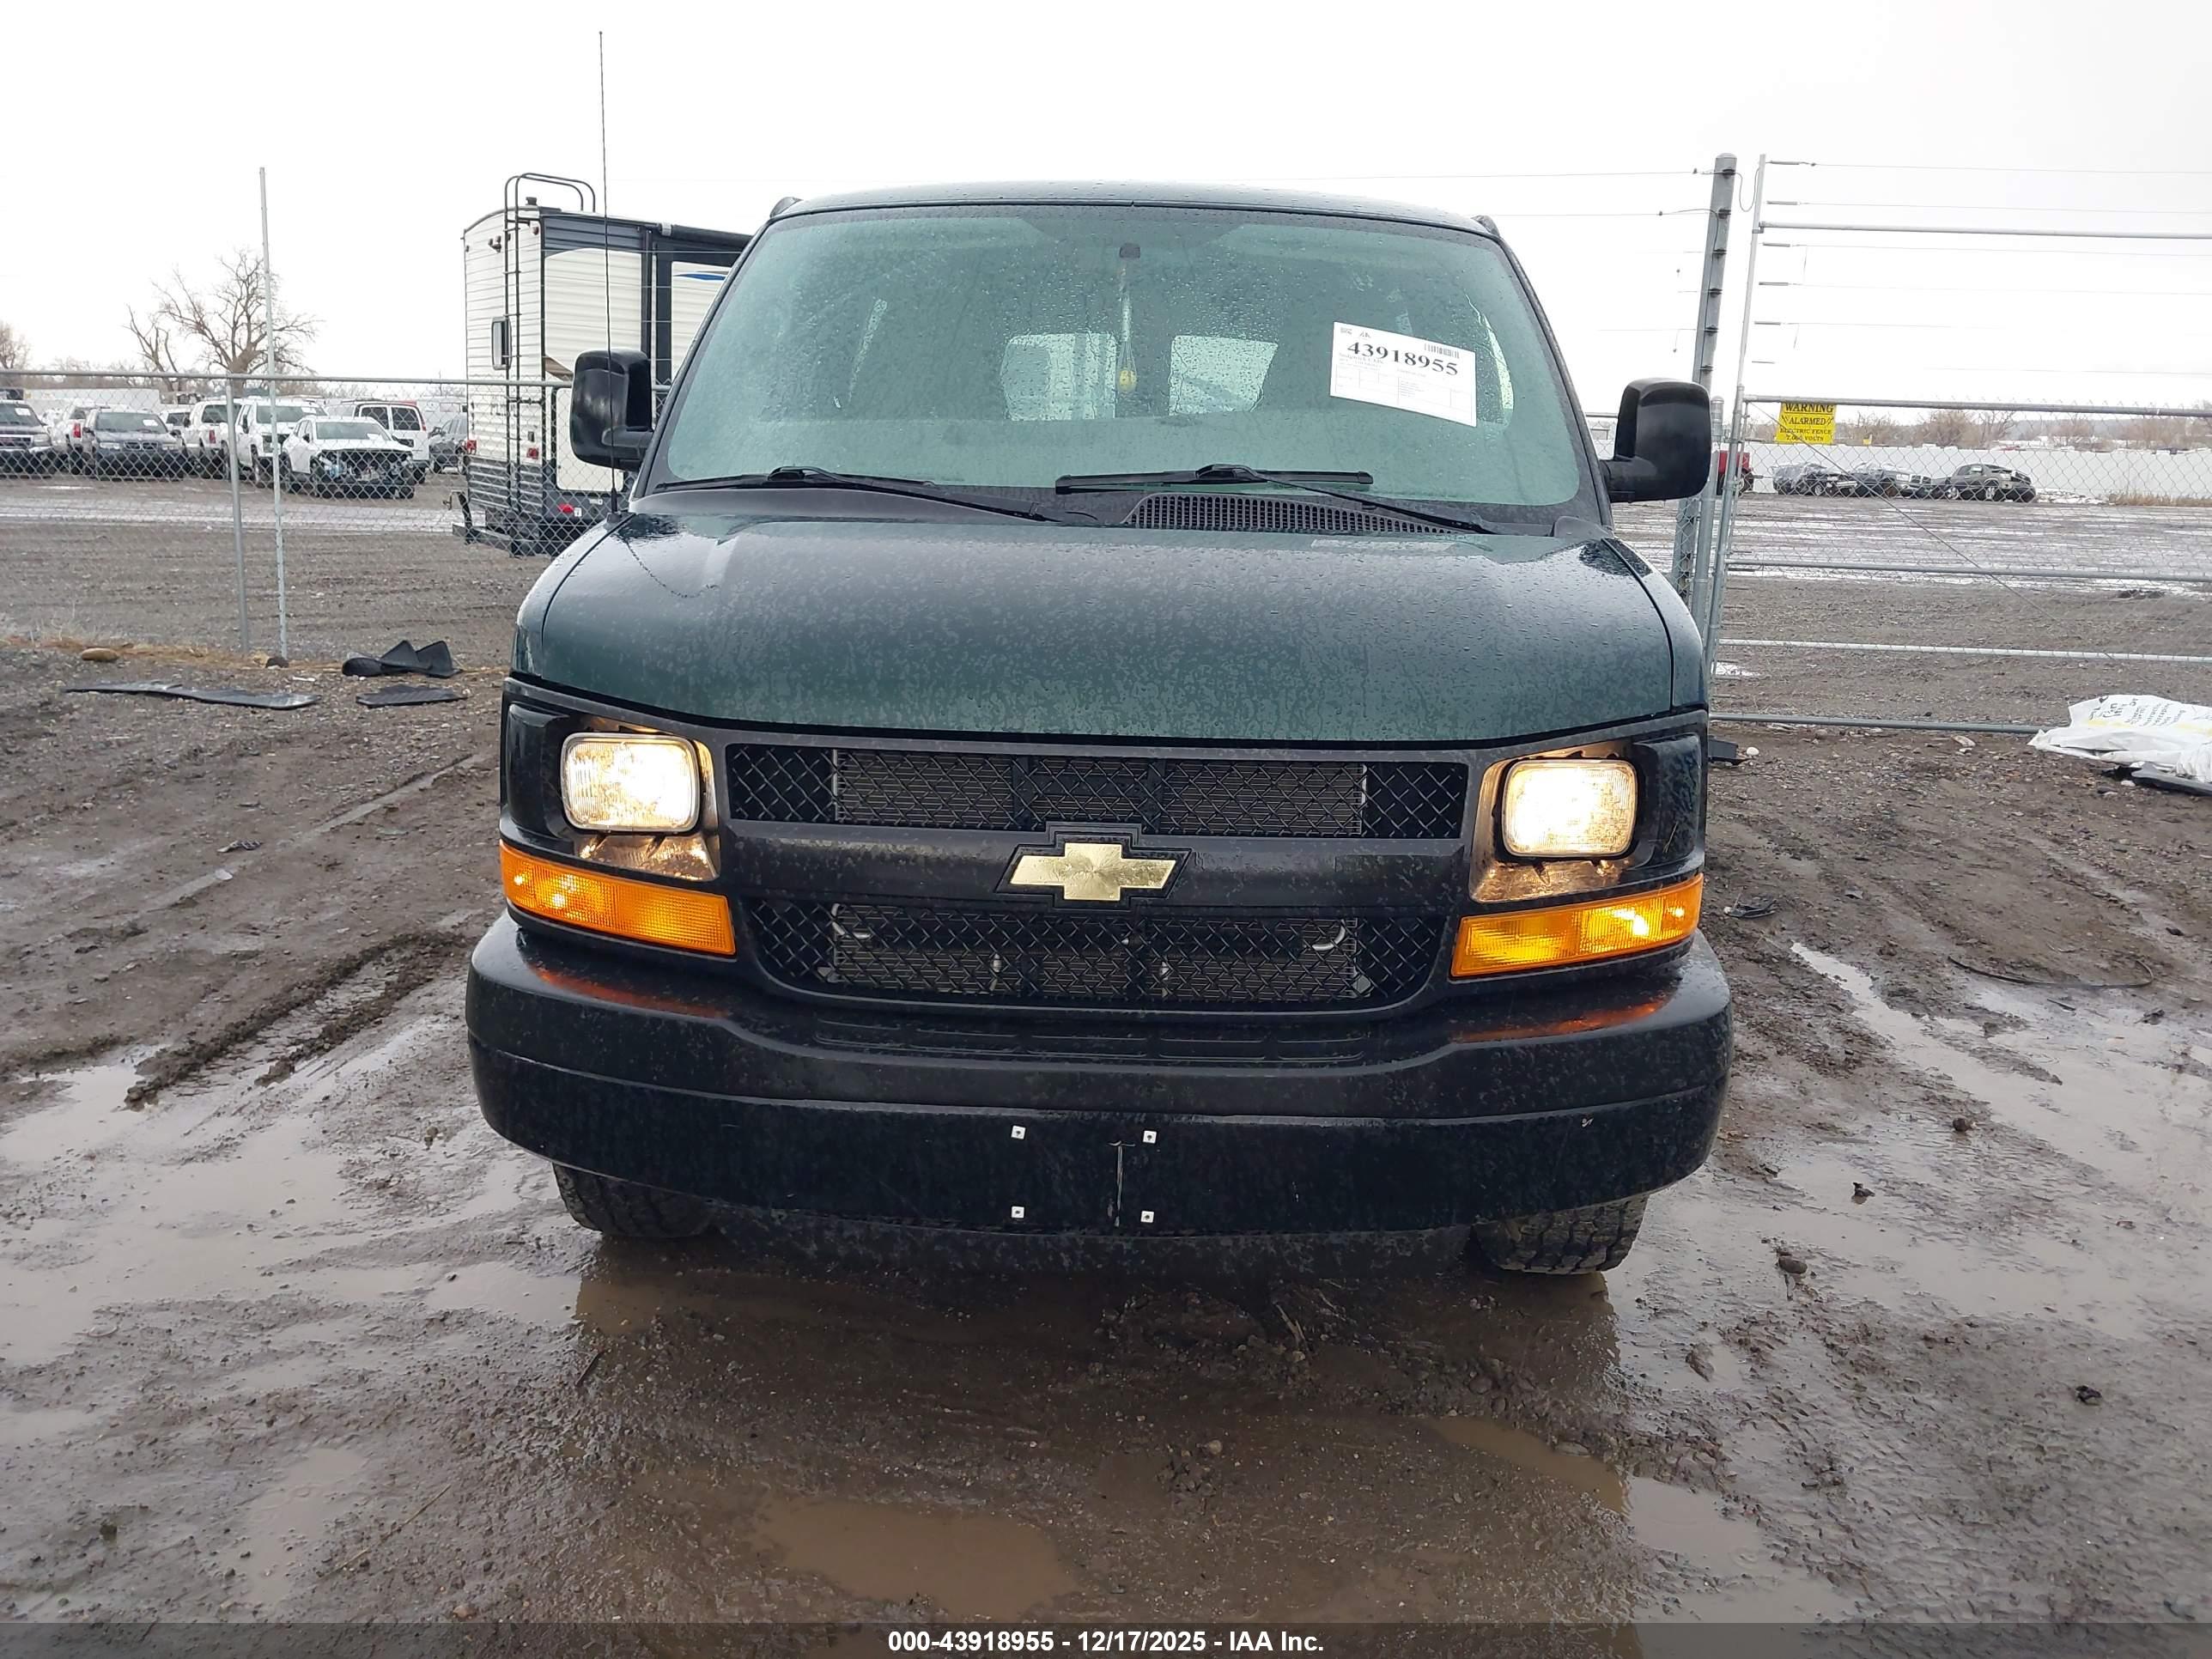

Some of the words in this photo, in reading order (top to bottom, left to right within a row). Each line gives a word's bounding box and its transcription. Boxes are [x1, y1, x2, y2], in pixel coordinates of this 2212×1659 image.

[1346, 342, 1459, 376] 43918955
[1785, 403, 1834, 413] WARNING
[1789, 416, 1826, 426] ALARMED
